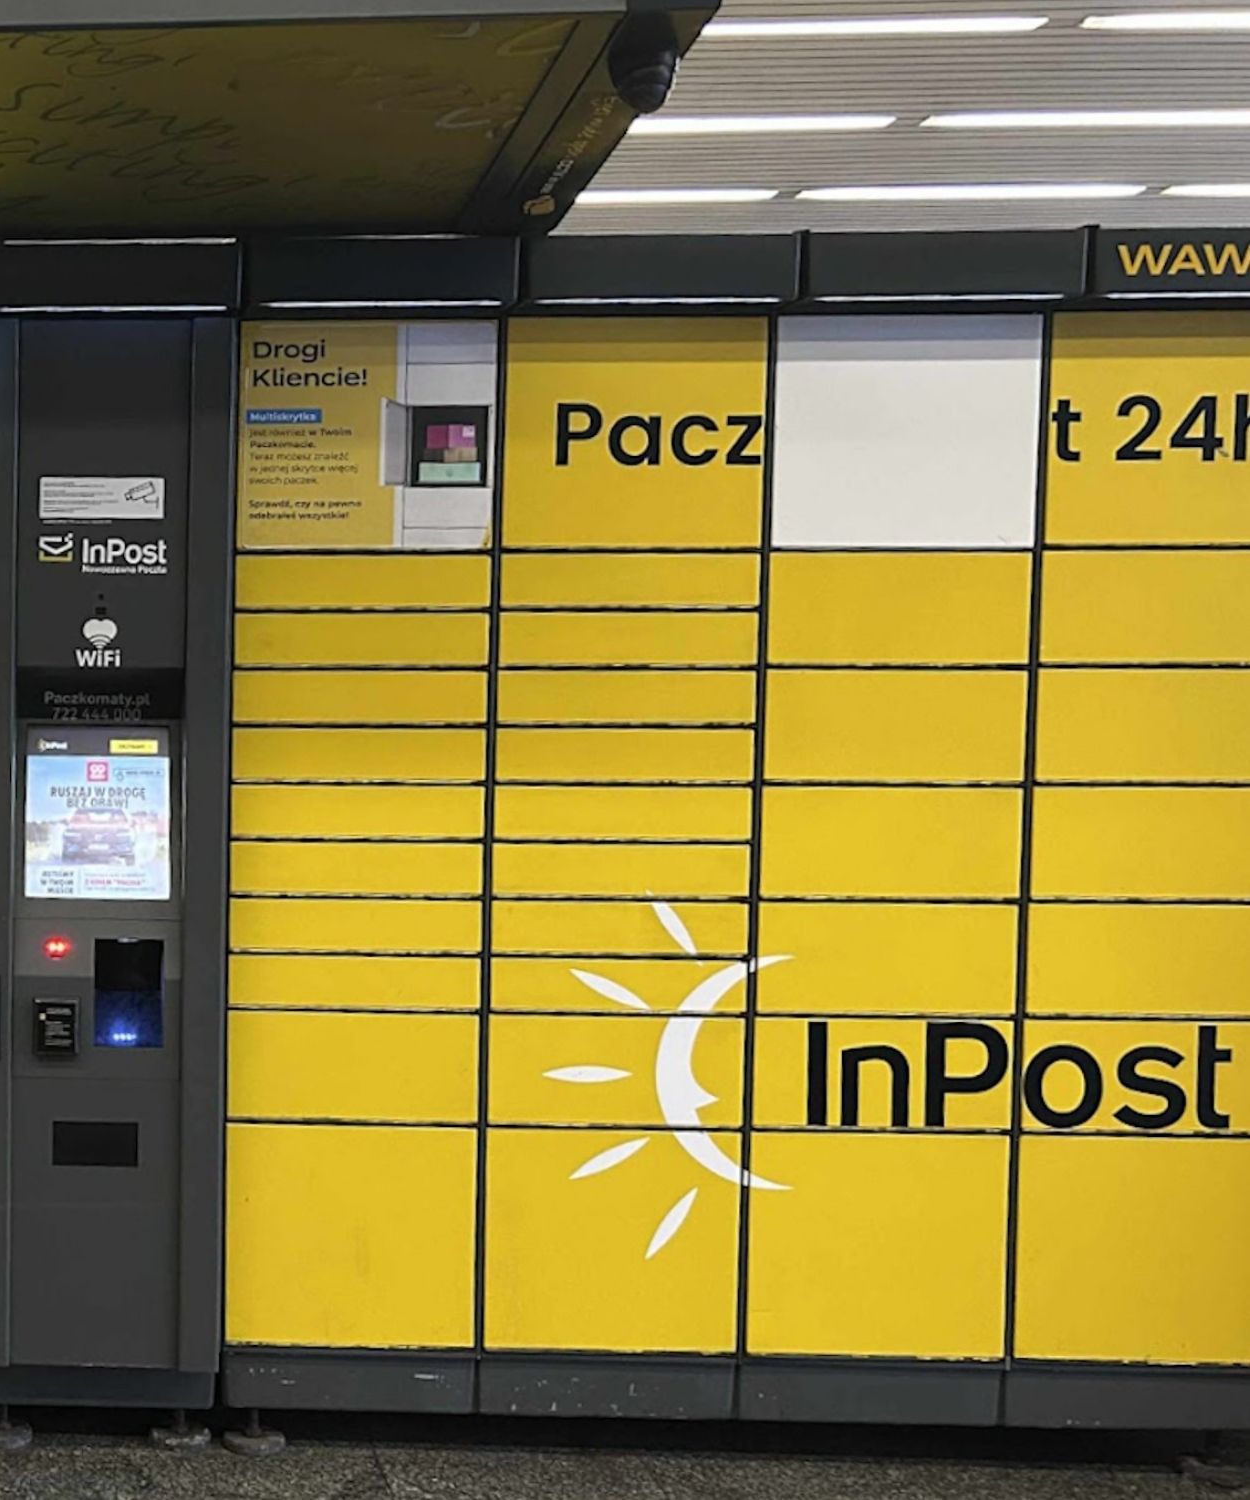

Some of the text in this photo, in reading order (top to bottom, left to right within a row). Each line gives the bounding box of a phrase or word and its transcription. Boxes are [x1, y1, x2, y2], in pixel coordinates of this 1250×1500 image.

[1117, 244, 1250, 276] WAW
[253, 339, 326, 363] Drogi
[253, 366, 367, 388] Kliencie!
[249, 412, 318, 422] Multiskrytka
[320, 427, 352, 437] Twoim
[555, 402, 763, 466] Pacz
[1052, 399, 1082, 462] t
[295, 501, 311, 510] czy
[328, 501, 362, 510] pewno
[82, 538, 168, 564] InPost
[75, 649, 121, 668] WiFi
[44, 691, 151, 707] Paczkomaty.pl
[52, 707, 143, 722] 722 444 000
[50, 786, 92, 798] RUSZAJ
[94, 786, 106, 797] W
[807, 1021, 1232, 1129] InPost
